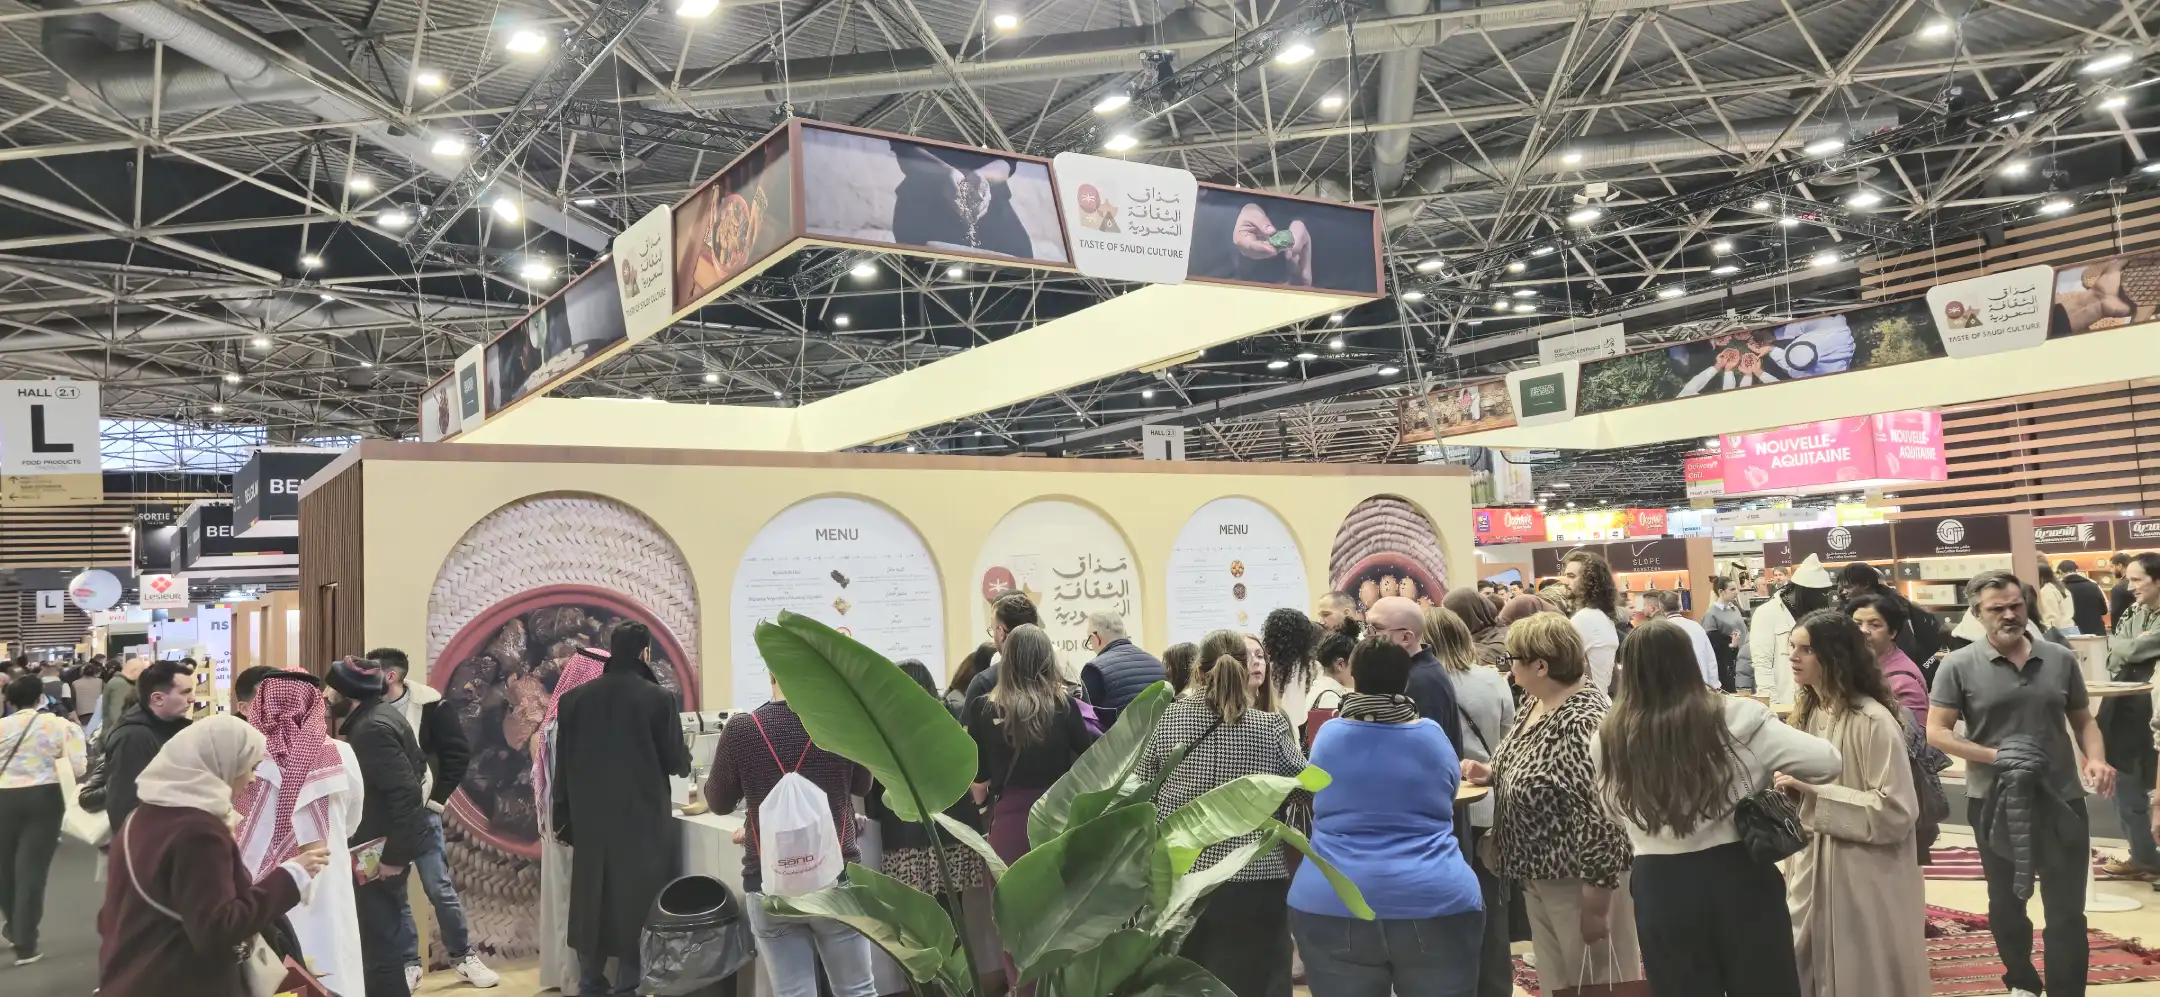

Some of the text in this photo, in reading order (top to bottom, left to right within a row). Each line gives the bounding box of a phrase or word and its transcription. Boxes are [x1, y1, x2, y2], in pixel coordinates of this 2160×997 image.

[1079, 239, 1184, 259] TASTE OF SAUDI CULTURE
[1948, 322, 2041, 343] TASTE OF SAUDI CULTURE
[18, 388, 76, 397] HALL 2.1
[31, 404, 74, 453] L
[1755, 433, 1837, 456] NOUVELLE-
[1771, 447, 1852, 469] AQUITAINE
[1899, 445, 1937, 461] AQUITAINE
[138, 512, 170, 521] SORTIE
[815, 528, 859, 541] MENU
[1219, 524, 1249, 535] MENU
[45, 595, 57, 609] L
